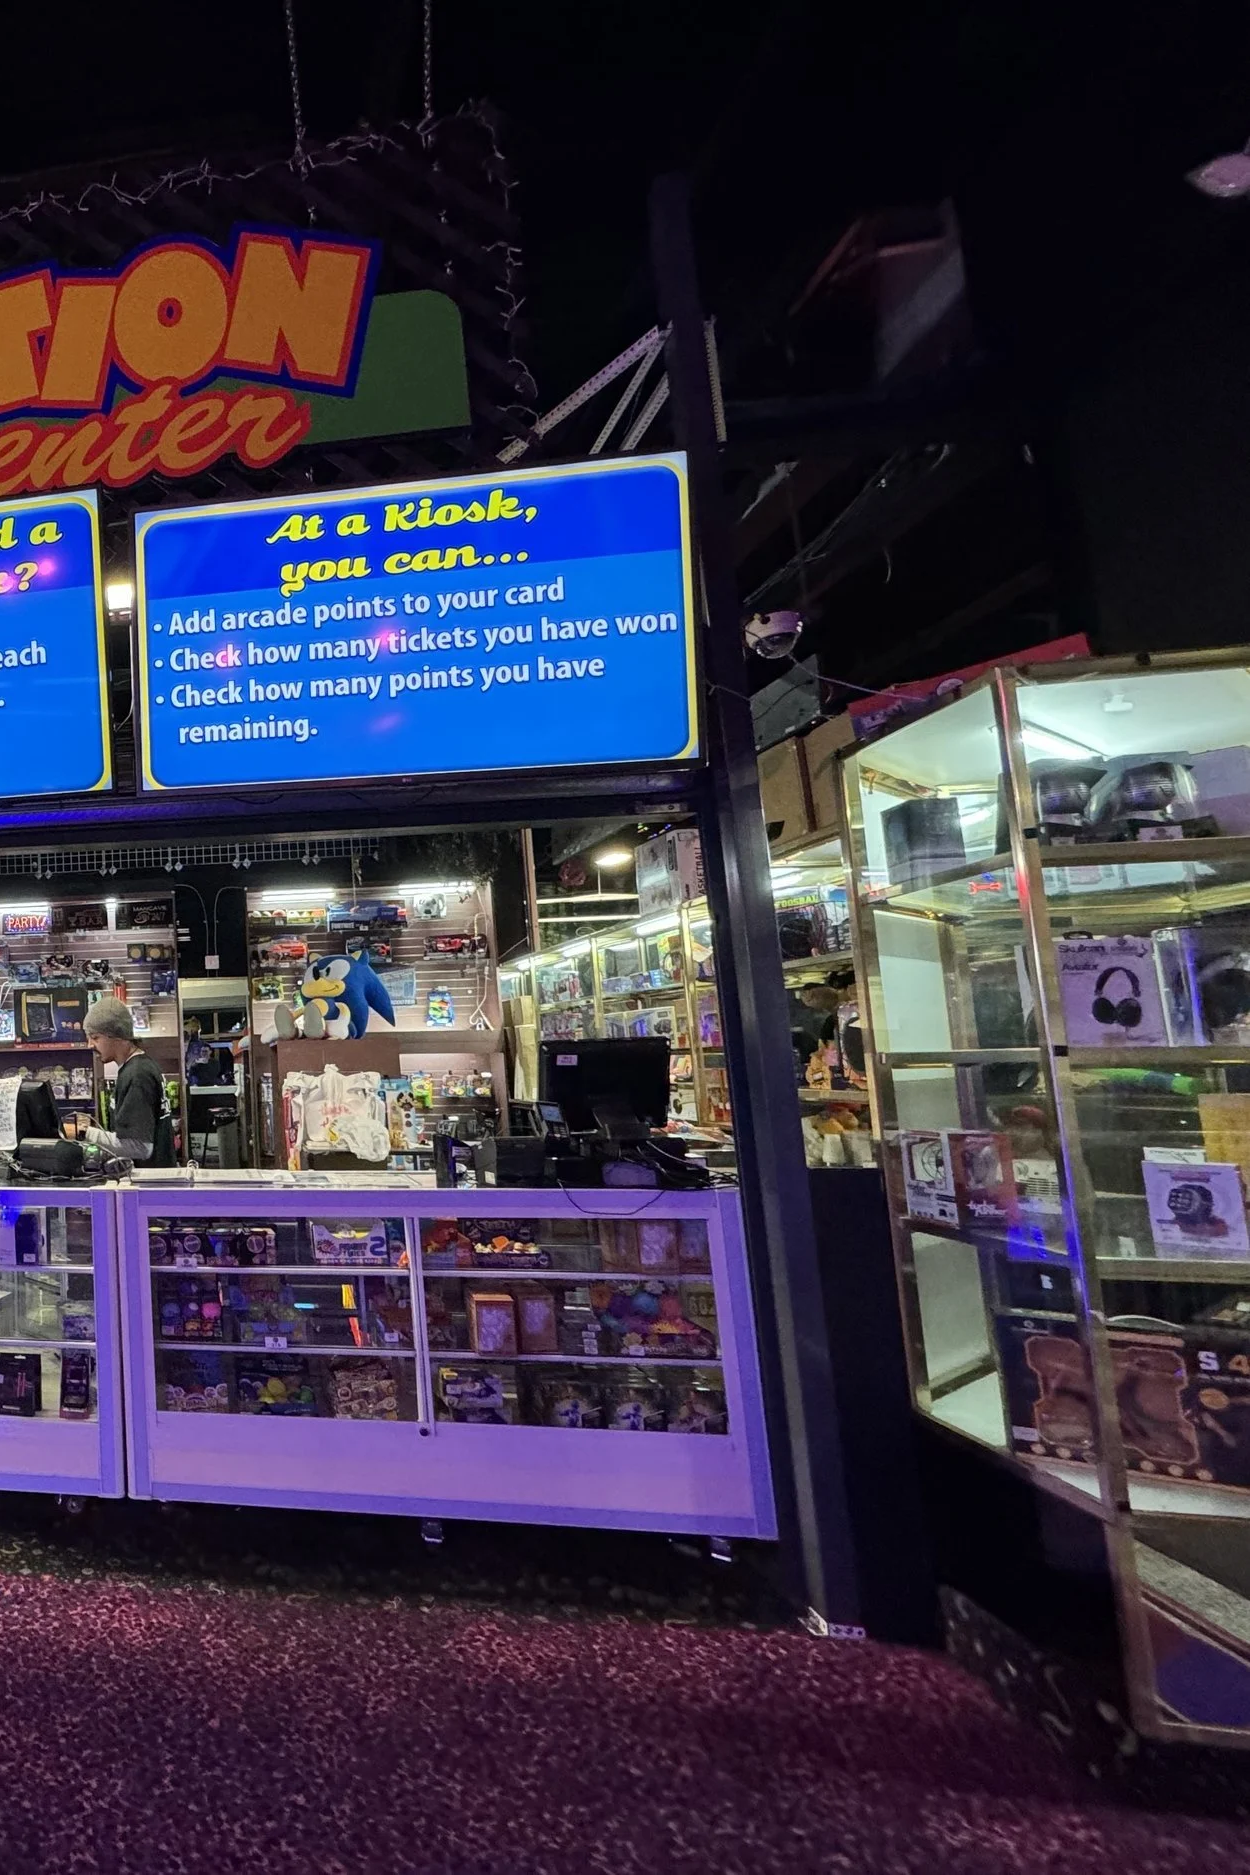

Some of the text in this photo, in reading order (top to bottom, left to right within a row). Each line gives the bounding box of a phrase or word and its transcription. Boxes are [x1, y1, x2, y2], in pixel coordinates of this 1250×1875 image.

[29, 521, 63, 546] a
[265, 489, 538, 544] At a Kiosk,
[280, 543, 529, 597] you can...
[168, 576, 564, 635] Add arcade points to your card
[169, 613, 677, 671] Check how many tickets you have won
[171, 656, 605, 708] Check how many points you have
[179, 713, 318, 744] remaining.
[694, 846, 707, 897] ASKETBALL
